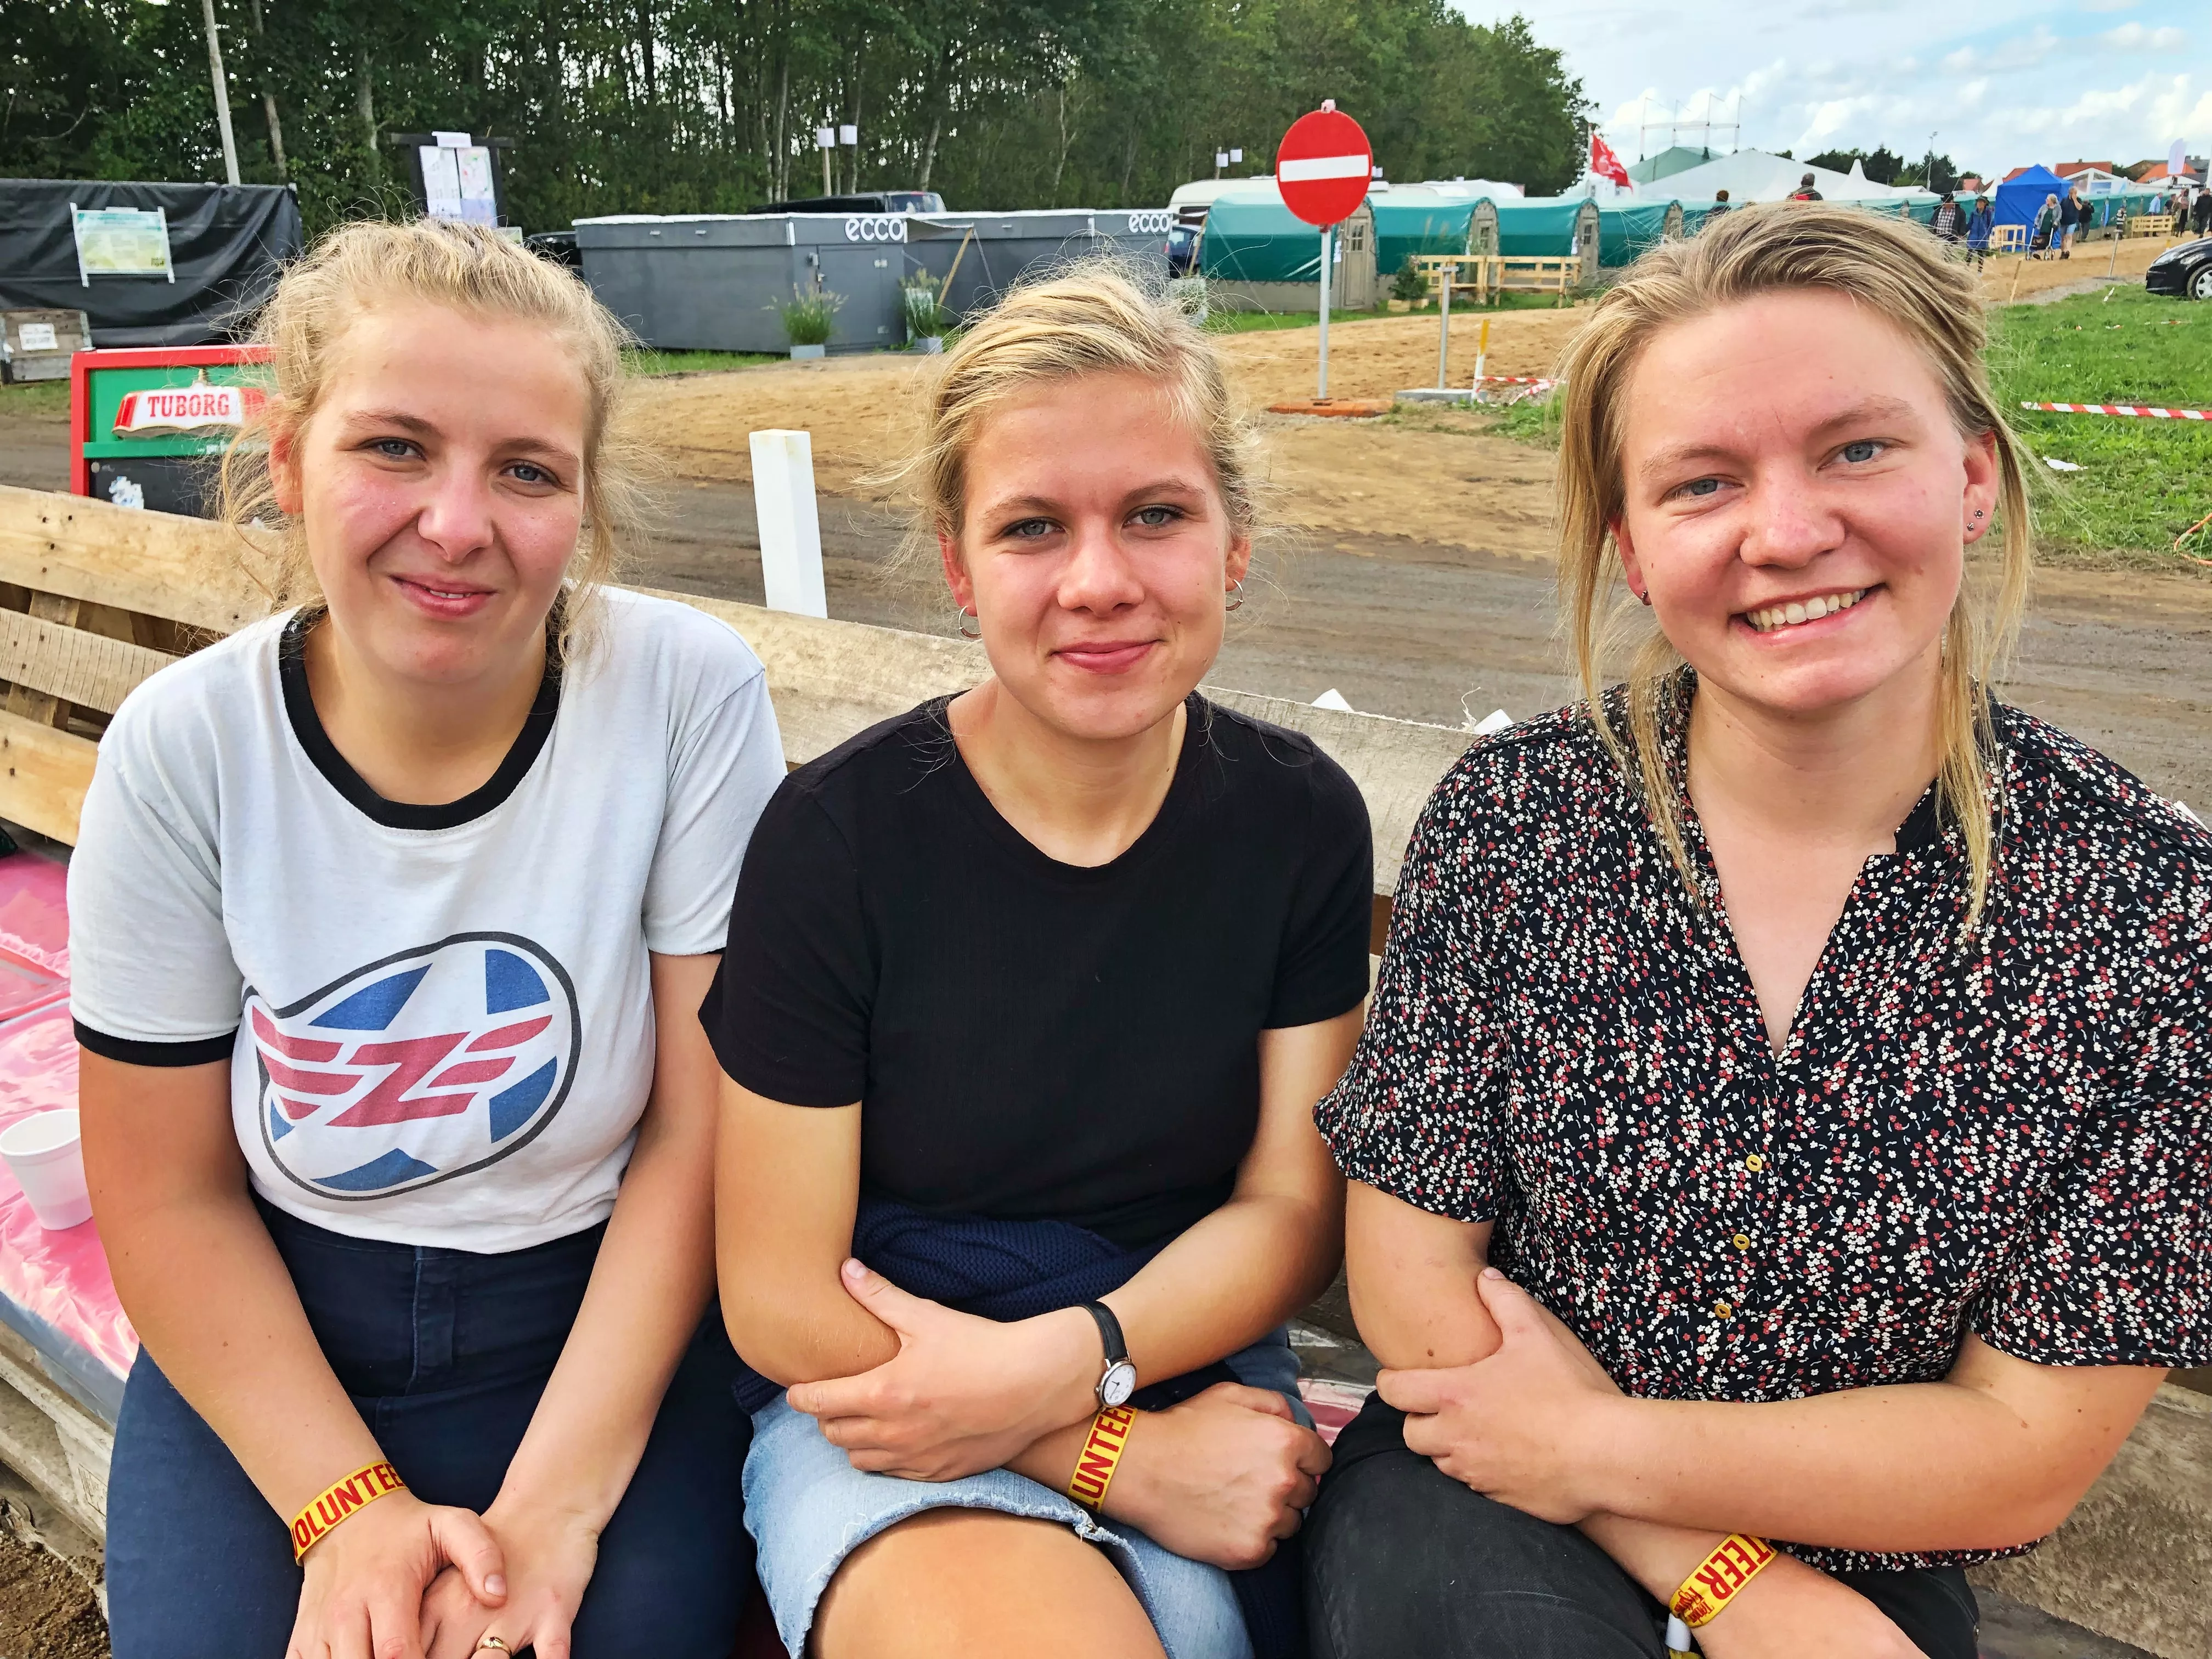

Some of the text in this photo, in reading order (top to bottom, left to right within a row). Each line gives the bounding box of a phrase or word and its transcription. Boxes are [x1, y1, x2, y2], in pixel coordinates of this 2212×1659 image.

[844, 218, 904, 241] ecco
[1128, 213, 1171, 233] ecco
[147, 393, 230, 417] TUBORG
[1695, 1534, 1774, 1600] TEER
